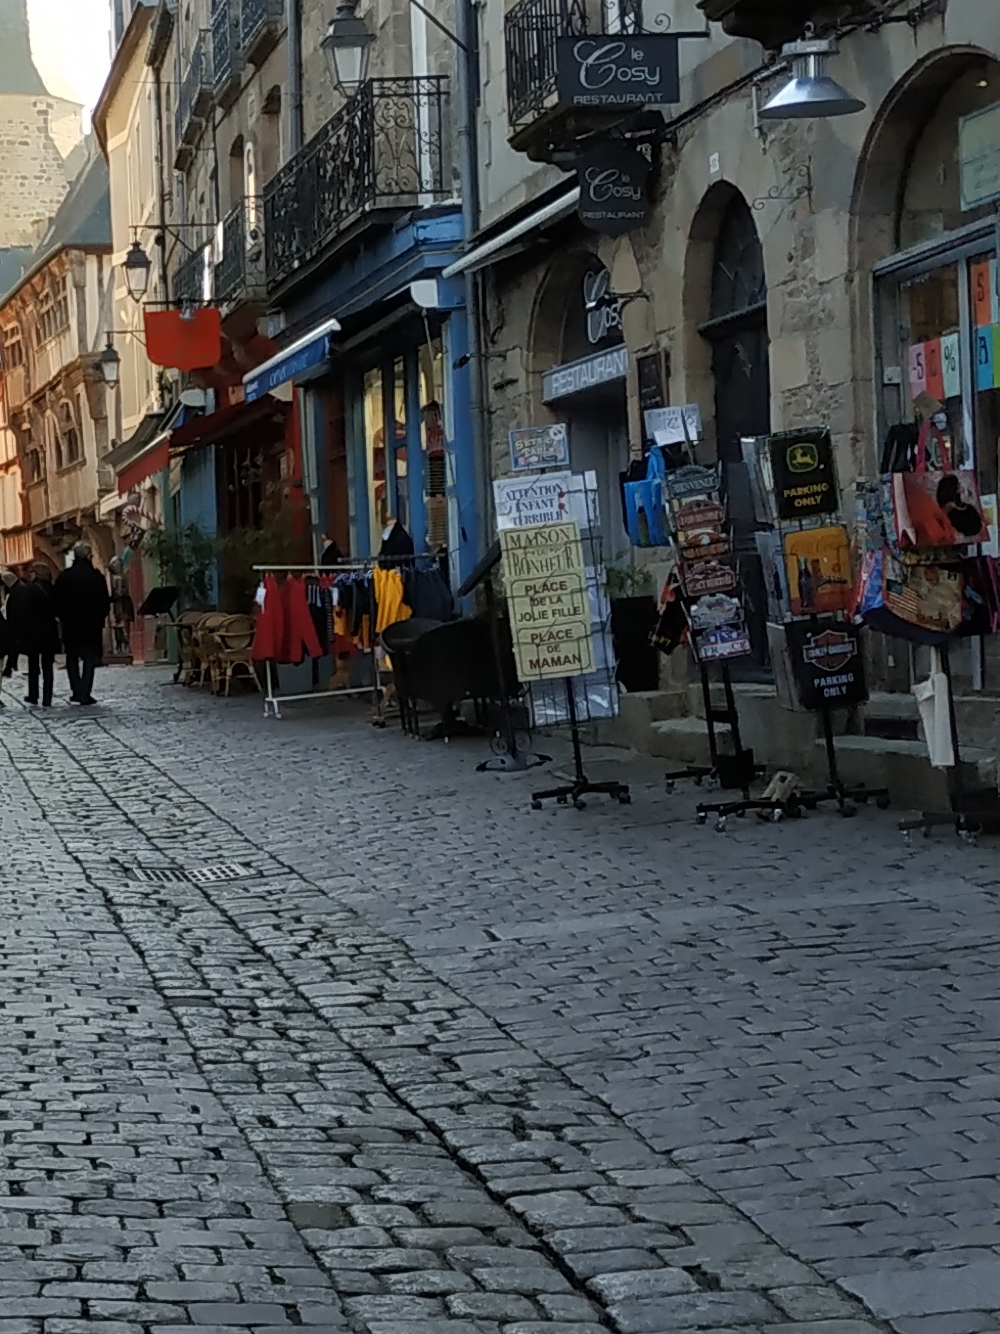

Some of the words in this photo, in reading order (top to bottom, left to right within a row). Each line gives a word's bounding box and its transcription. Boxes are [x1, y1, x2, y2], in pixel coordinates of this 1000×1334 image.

[630, 47, 644, 61] le
[573, 40, 660, 89] Cosy
[573, 93, 664, 105] RESTAURANT
[585, 167, 641, 202] Cosy
[582, 210, 645, 219] RESTAURANT
[506, 483, 563, 501] ATTENTION
[783, 483, 829, 497] PARKING
[516, 498, 555, 512] ENFANT
[794, 494, 822, 507] ONLY
[513, 511, 563, 526] TERRIBLE
[510, 527, 571, 547] MAISON
[511, 546, 574, 576] BONHEUR
[525, 581, 568, 596] PLACE
[533, 597, 547, 606] DE
[549, 596, 563, 604] LA
[518, 610, 549, 622] JOLIE
[552, 606, 581, 617] FILLE
[531, 629, 573, 643] PLACE
[547, 644, 561, 653] DE
[529, 654, 581, 669] MAMAN
[814, 673, 854, 688] PARKING
[824, 685, 847, 698] ONLY
